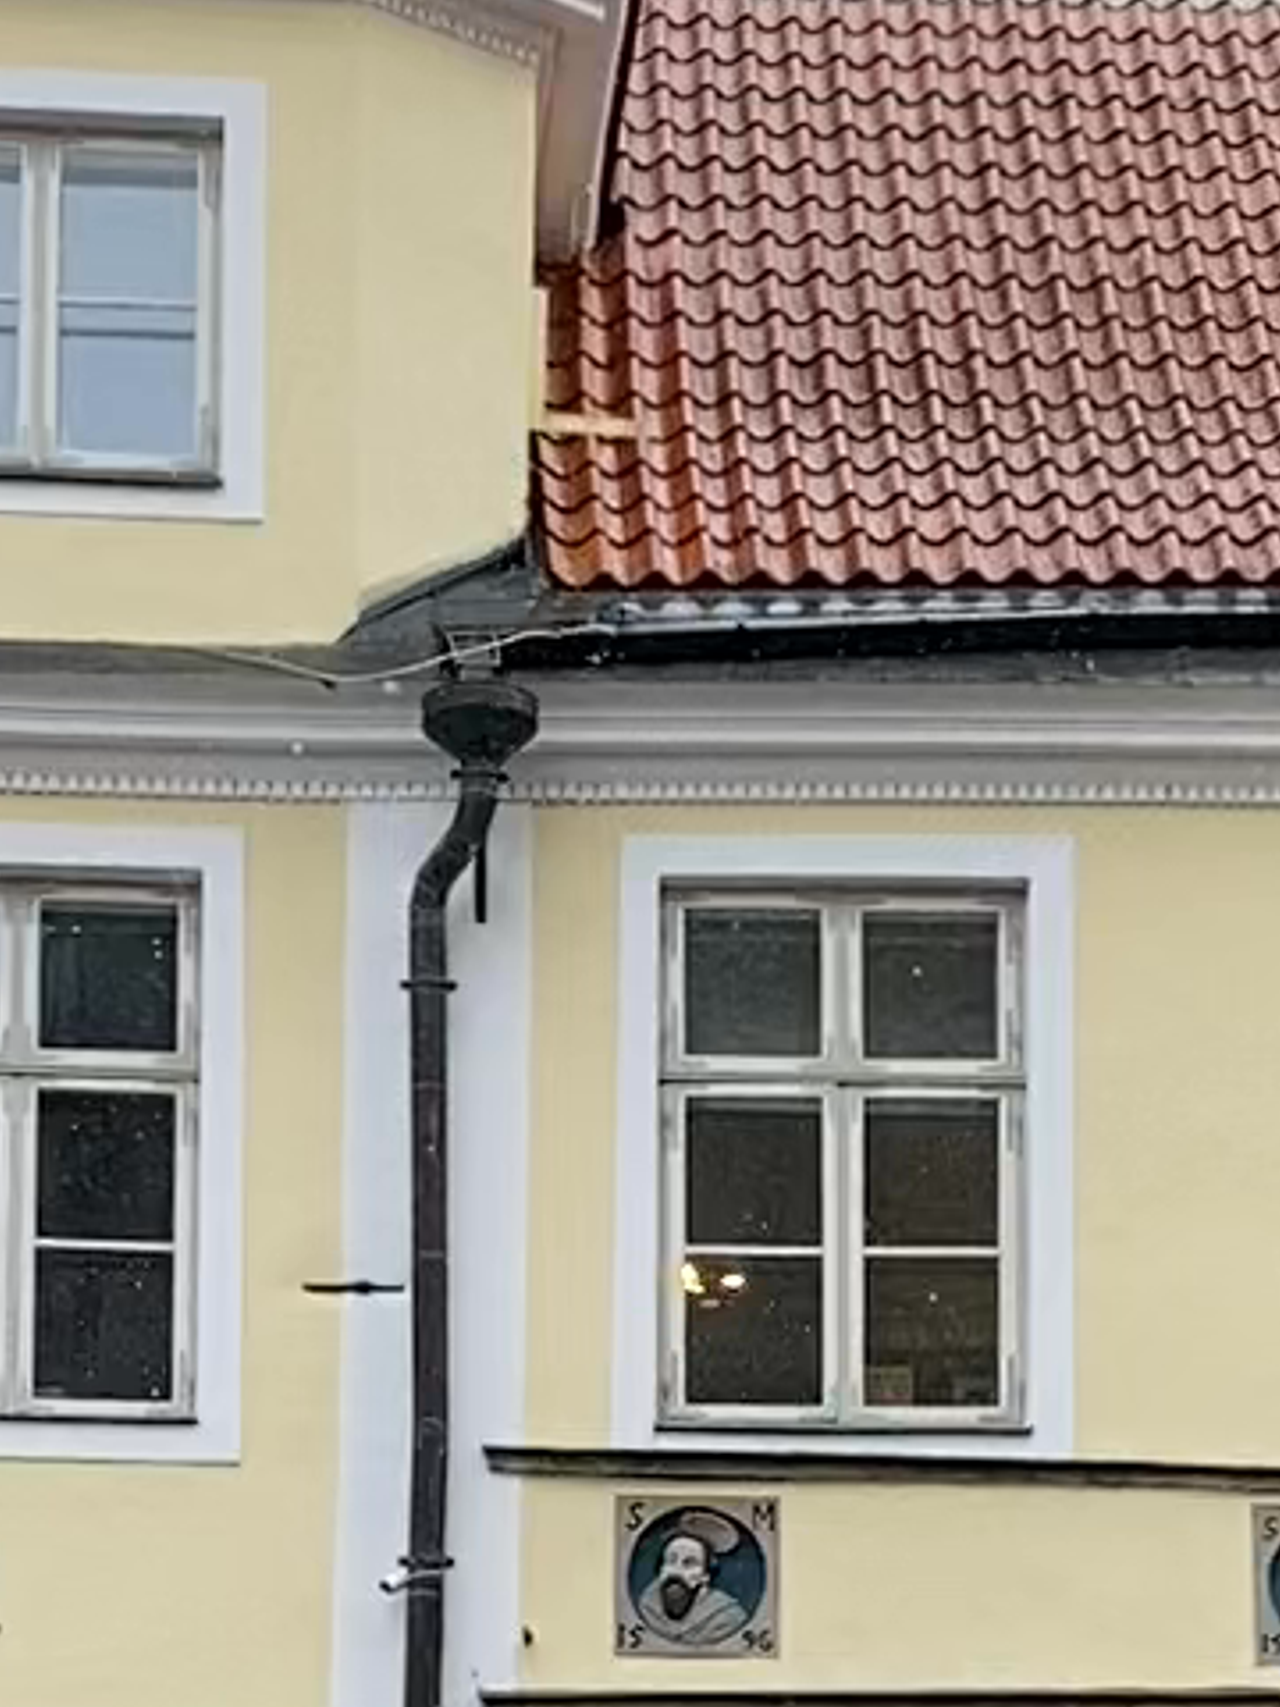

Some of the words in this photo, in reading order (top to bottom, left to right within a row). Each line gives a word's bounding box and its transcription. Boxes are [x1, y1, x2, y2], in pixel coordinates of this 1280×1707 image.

[625, 1501, 645, 1531] S
[752, 1504, 776, 1532] M
[1261, 1515, 1279, 1541] S
